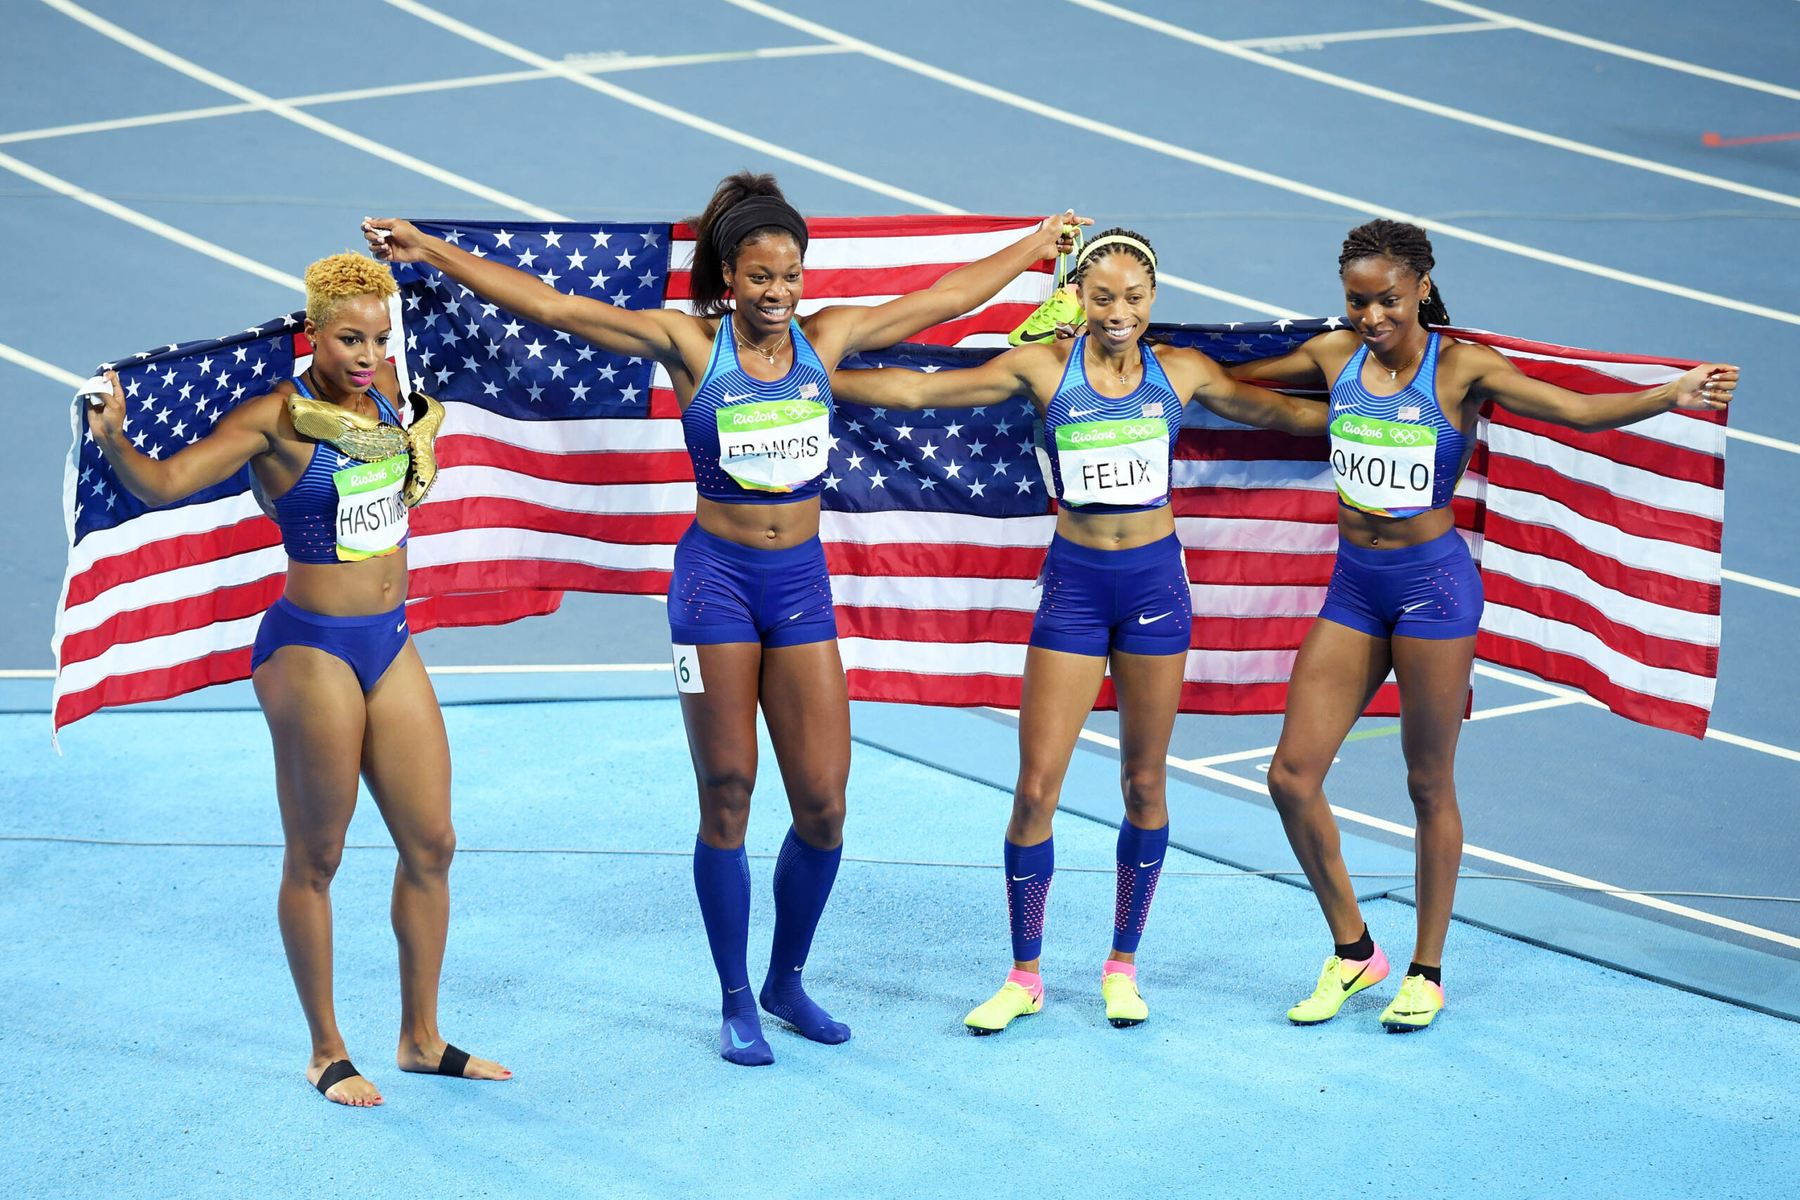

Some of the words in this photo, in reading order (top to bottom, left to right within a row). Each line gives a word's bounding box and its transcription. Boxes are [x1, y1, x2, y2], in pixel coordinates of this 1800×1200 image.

[733, 409, 779, 425] Rio2016
[1071, 428, 1116, 443] Rio2016
[1342, 421, 1383, 439] Rio2016
[728, 436, 818, 460] FRANCIS
[1082, 459, 1151, 491] FELIX
[1332, 449, 1428, 491] OKOLO
[679, 656, 690, 684] 6
